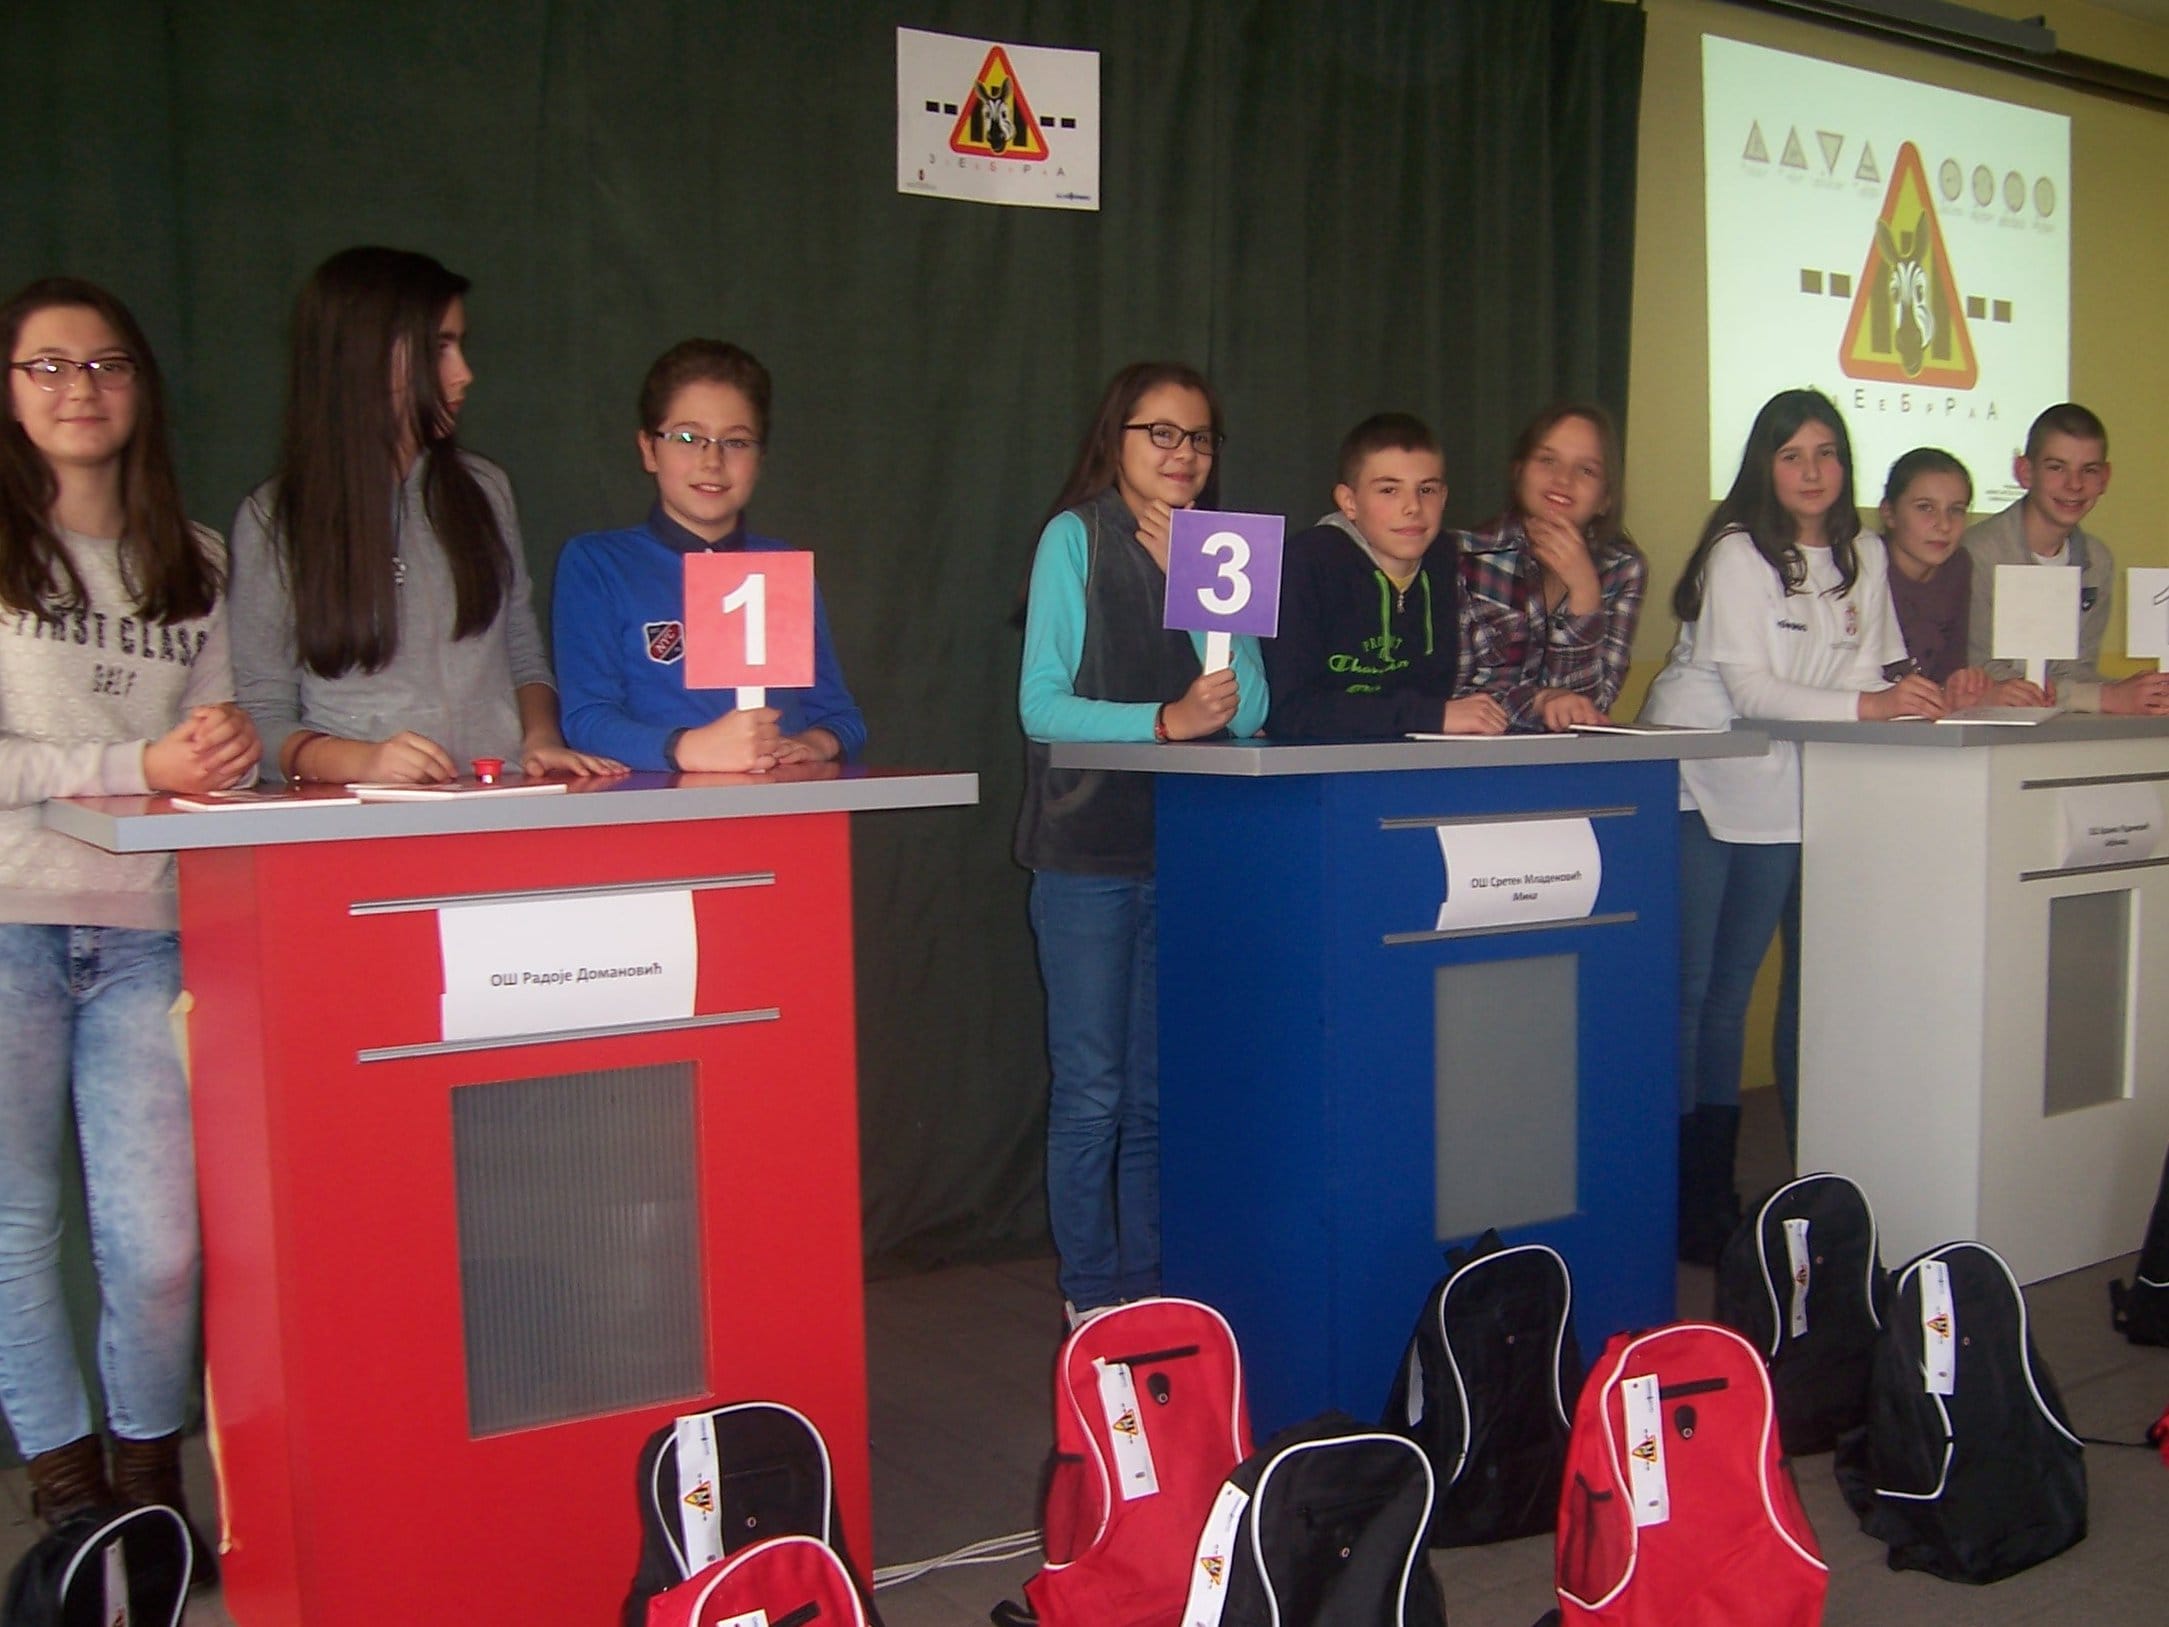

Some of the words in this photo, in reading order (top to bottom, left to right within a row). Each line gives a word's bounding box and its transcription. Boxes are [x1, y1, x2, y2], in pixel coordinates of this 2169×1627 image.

[1197, 531, 1252, 615] 3
[722, 573, 766, 665] 1
[655, 628, 676, 653] NYC
[1471, 876, 1489, 889] ОШ
[1490, 875, 1523, 889] Сретен
[490, 972, 518, 987] ОШ
[522, 968, 573, 985] Радоје
[576, 962, 663, 983] Домановић
